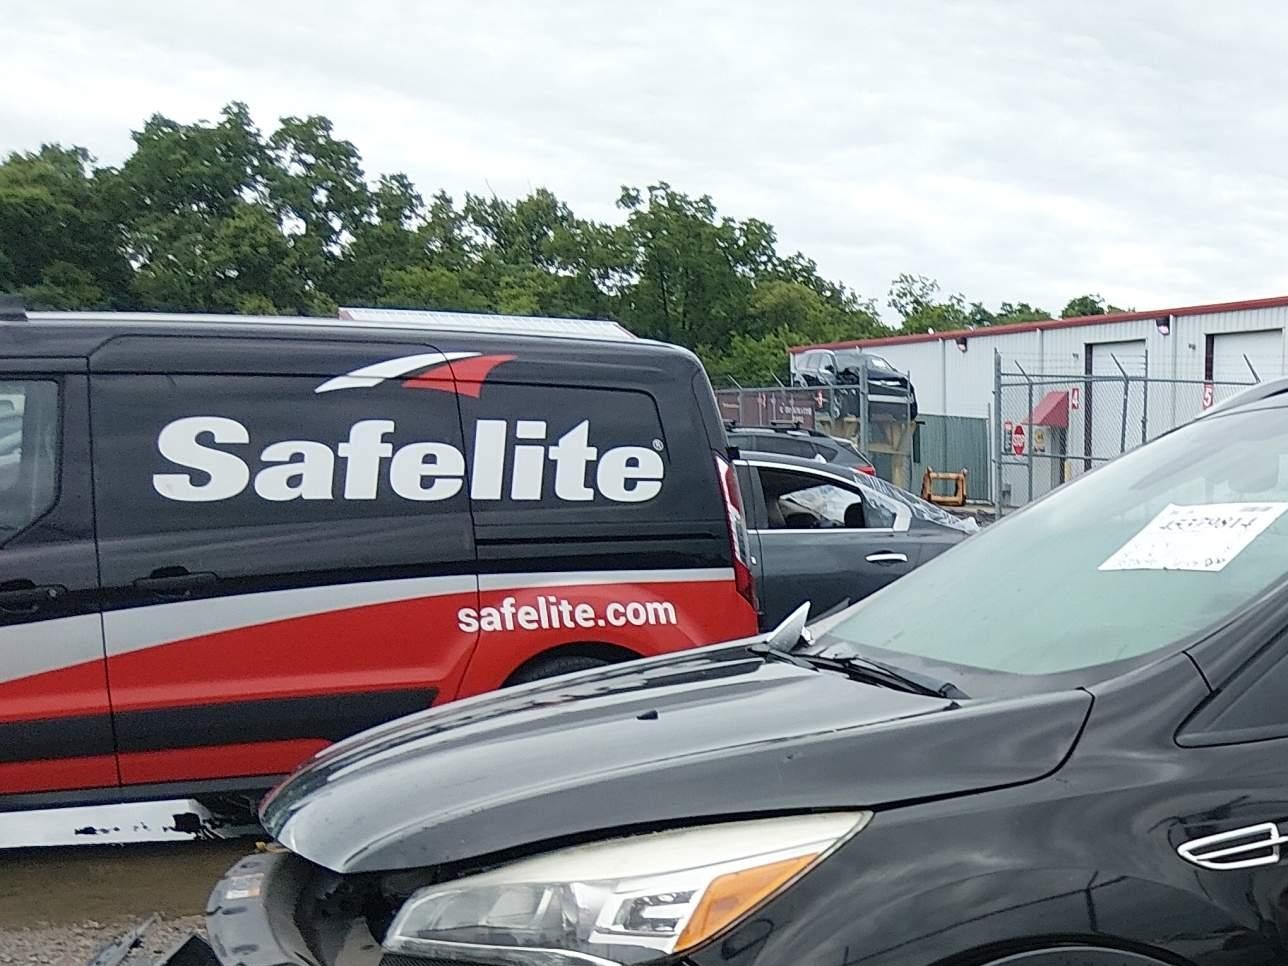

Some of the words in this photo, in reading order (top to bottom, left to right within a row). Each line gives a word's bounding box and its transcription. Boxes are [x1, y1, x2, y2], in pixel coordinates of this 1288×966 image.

[1203, 387, 1212, 407] 5
[152, 417, 664, 503] Safelite
[458, 594, 677, 633] safelite.com
